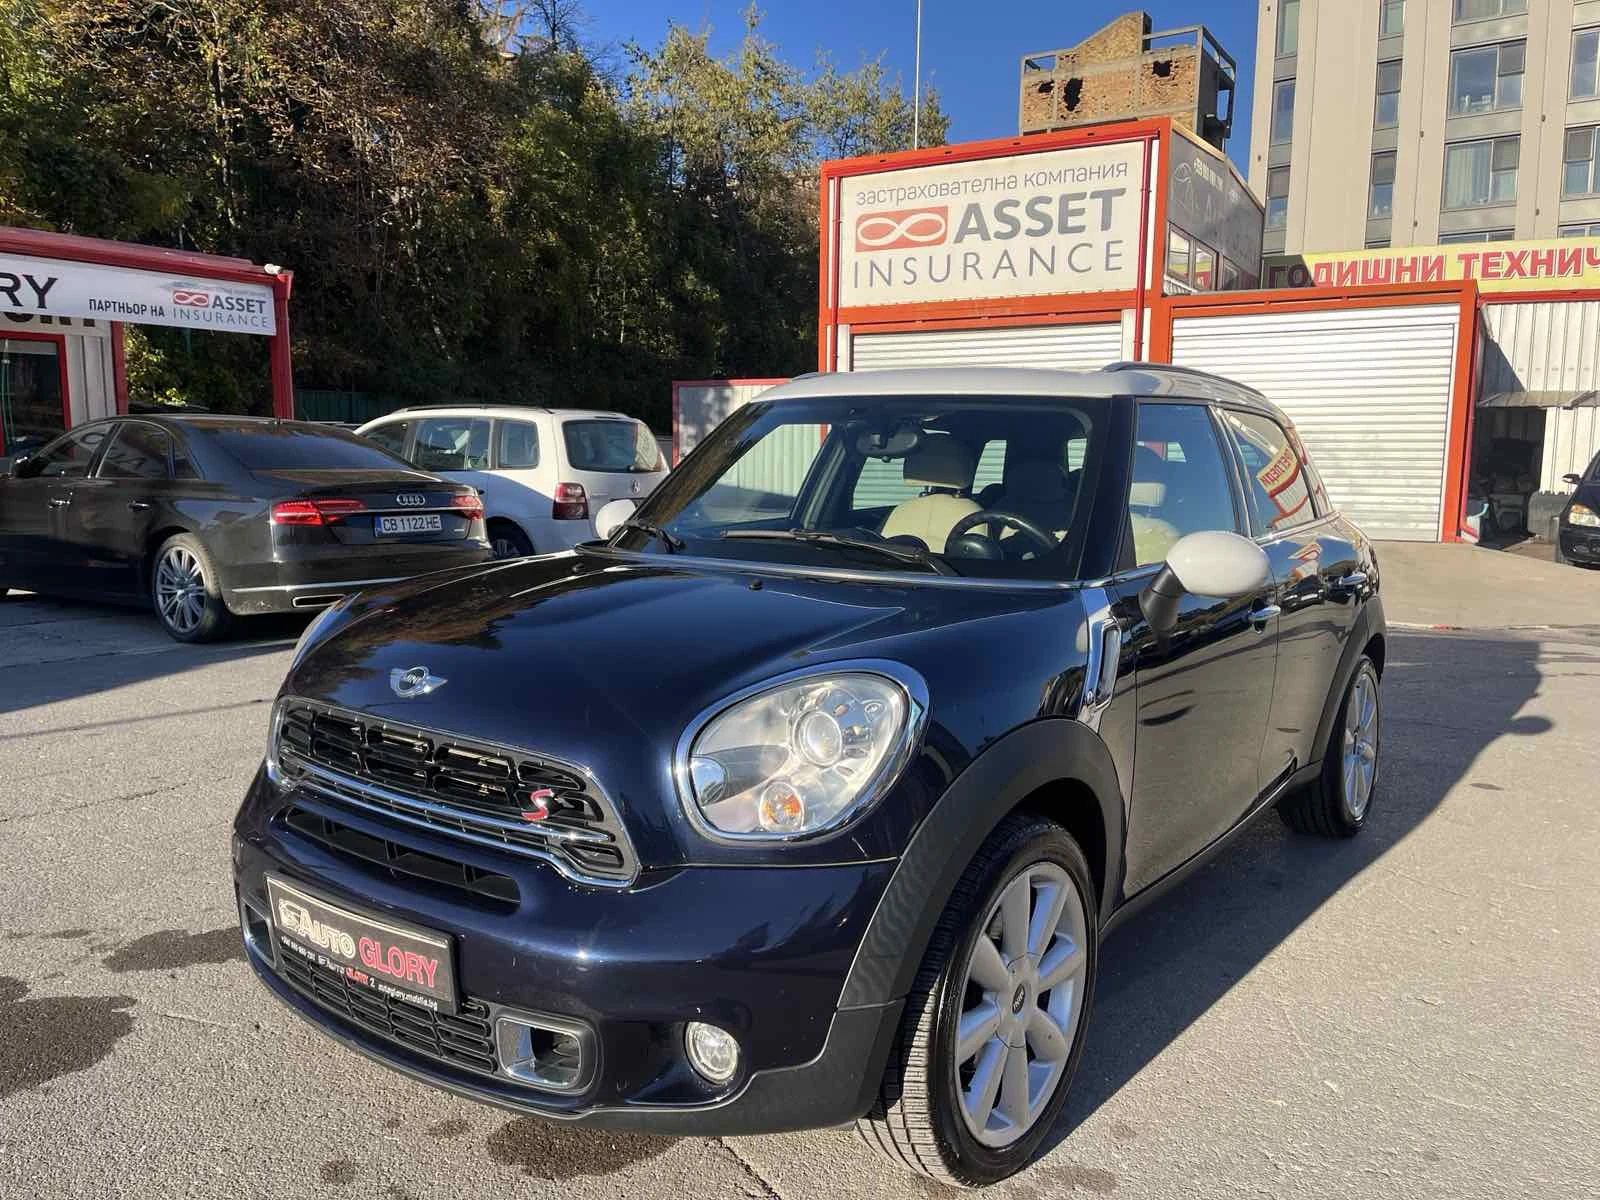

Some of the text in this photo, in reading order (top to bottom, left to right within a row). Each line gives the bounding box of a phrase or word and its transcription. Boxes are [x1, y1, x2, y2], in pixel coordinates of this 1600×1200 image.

[856, 162, 1128, 206] застрахователна компания
[953, 187, 1127, 244] ASSET
[854, 239, 1124, 289] INSURANCE
[1269, 254, 1446, 288] ГОДИШНИ
[89, 298, 165, 318] ПАРТНЬОР НА
[173, 307, 269, 328] INSURANCE
[211, 295, 267, 314] ASSET
[359, 936, 439, 988] GLORY
